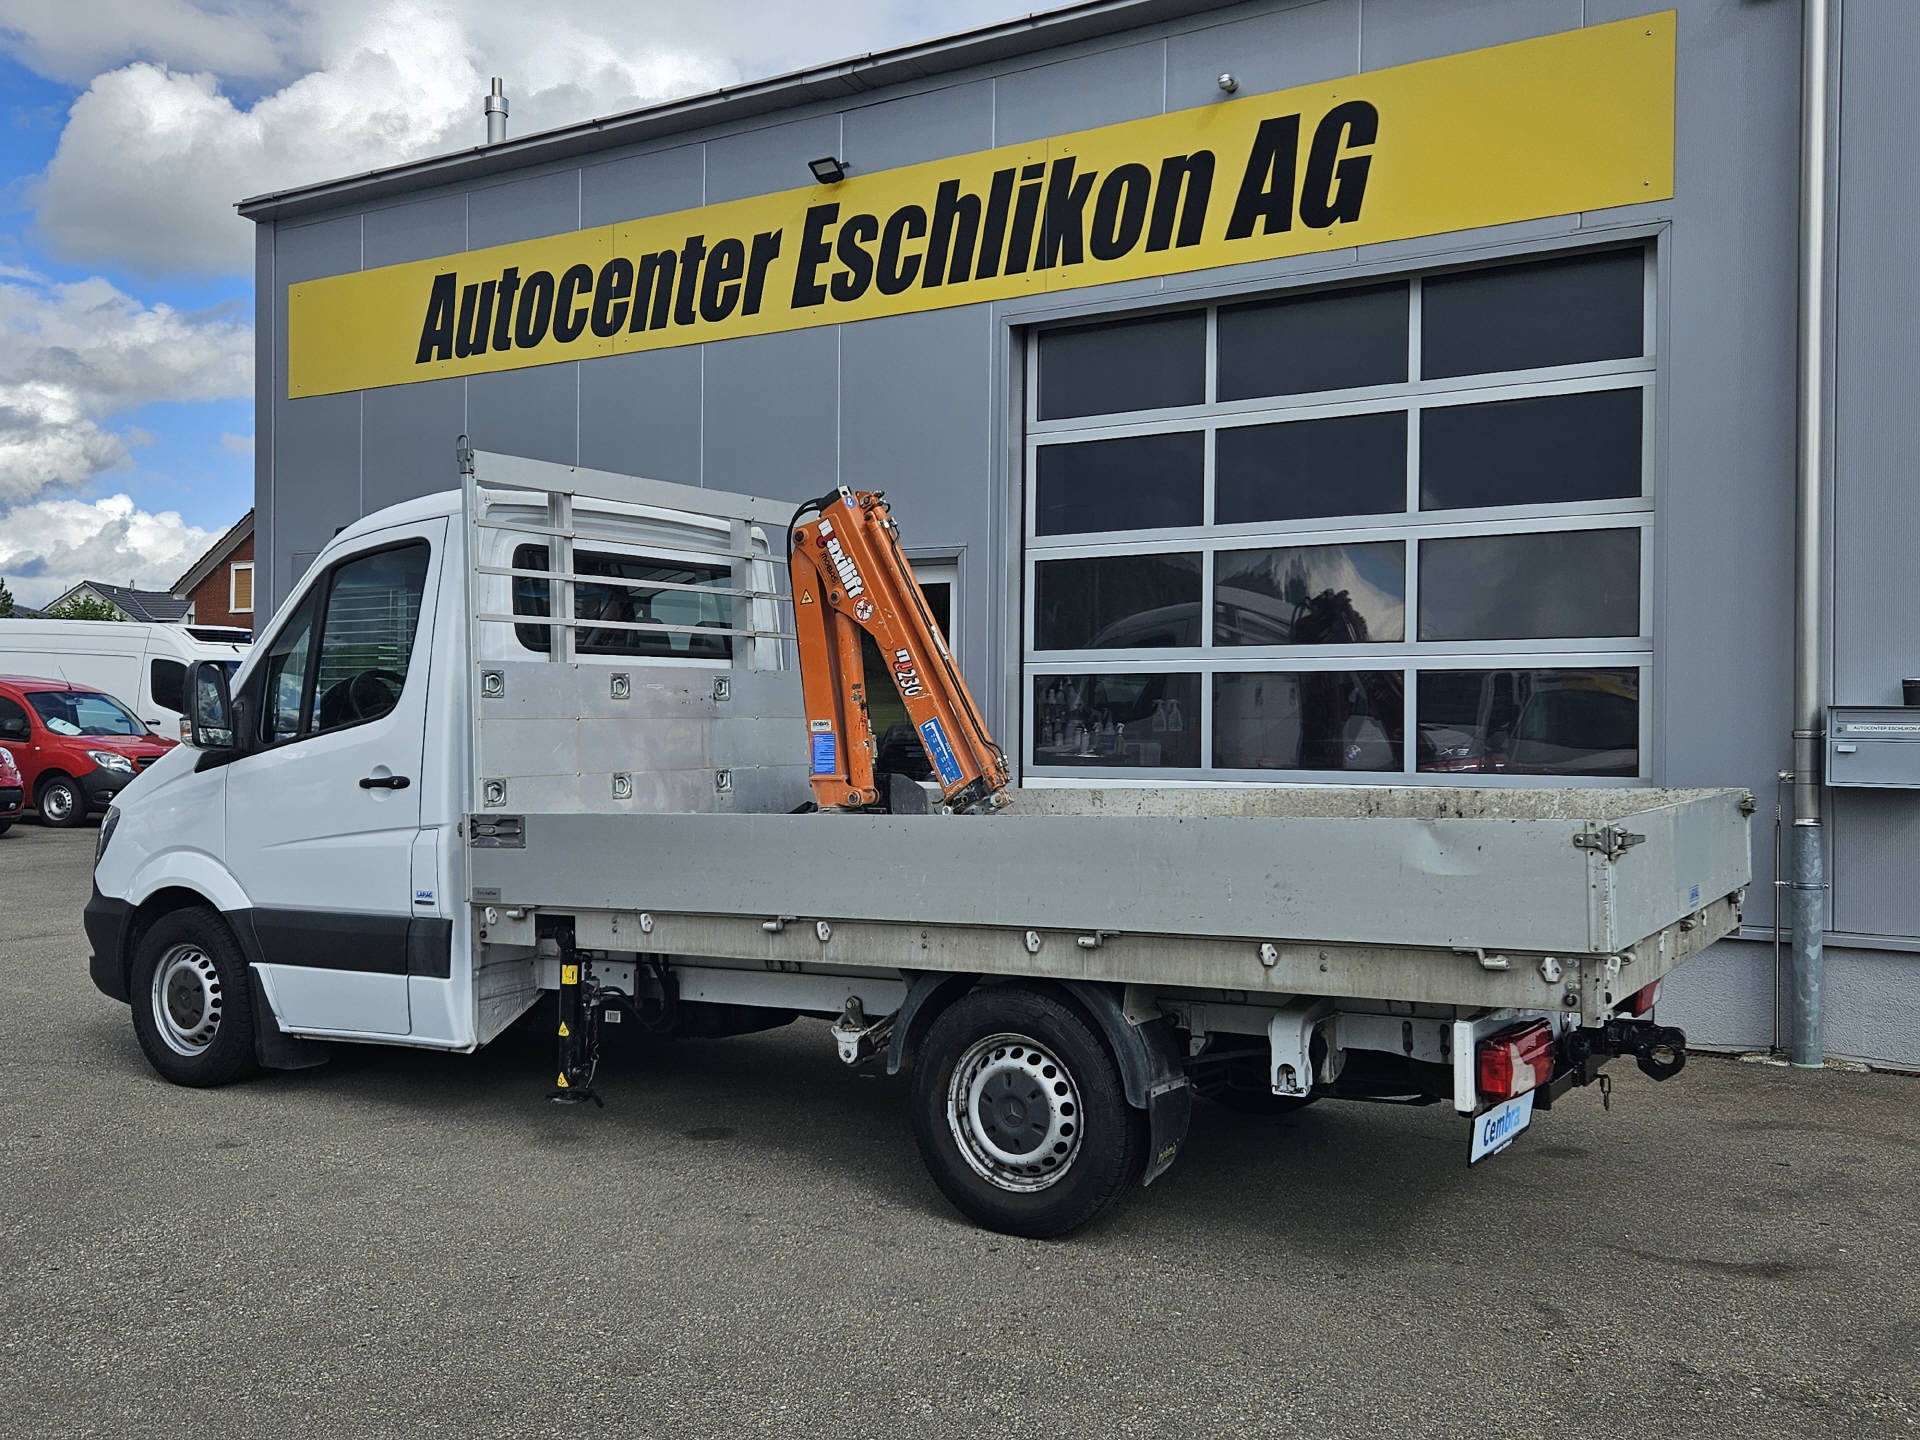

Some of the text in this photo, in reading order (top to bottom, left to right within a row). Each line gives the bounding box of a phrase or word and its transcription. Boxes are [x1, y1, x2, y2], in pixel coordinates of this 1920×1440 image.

[415, 100, 1379, 364] Autocenter Eschlikon AG
[816, 518, 865, 599] maxilift
[1483, 1105, 1521, 1147] Cembra
